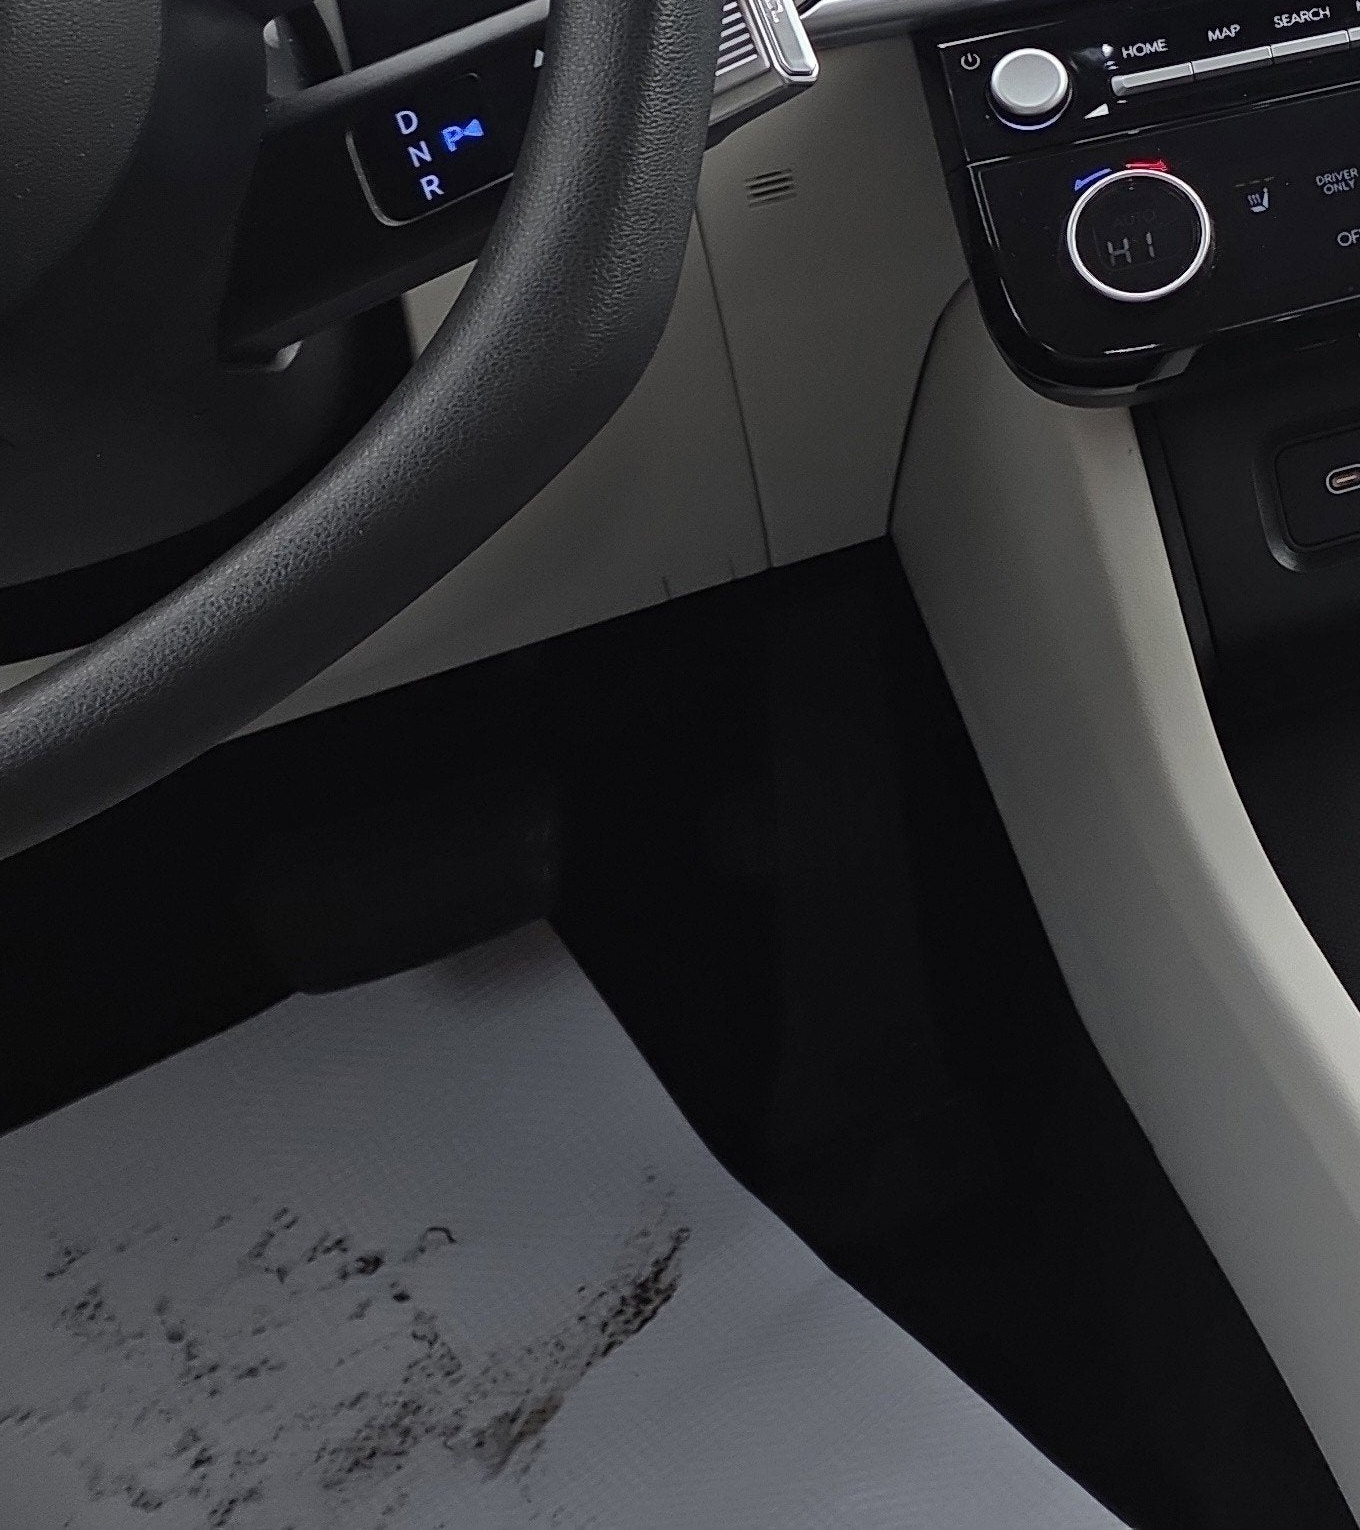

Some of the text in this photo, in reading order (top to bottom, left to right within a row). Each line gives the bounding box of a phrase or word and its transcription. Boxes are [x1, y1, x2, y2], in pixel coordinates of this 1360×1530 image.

[1273, 6, 1331, 30] SEARCH
[1207, 24, 1241, 43] MAP
[1121, 38, 1168, 59] HOME
[395, 110, 418, 135] D
[408, 140, 432, 167] N
[420, 174, 444, 200] R
[1315, 167, 1359, 185] DRIVER
[1323, 179, 1356, 195] ONLY
